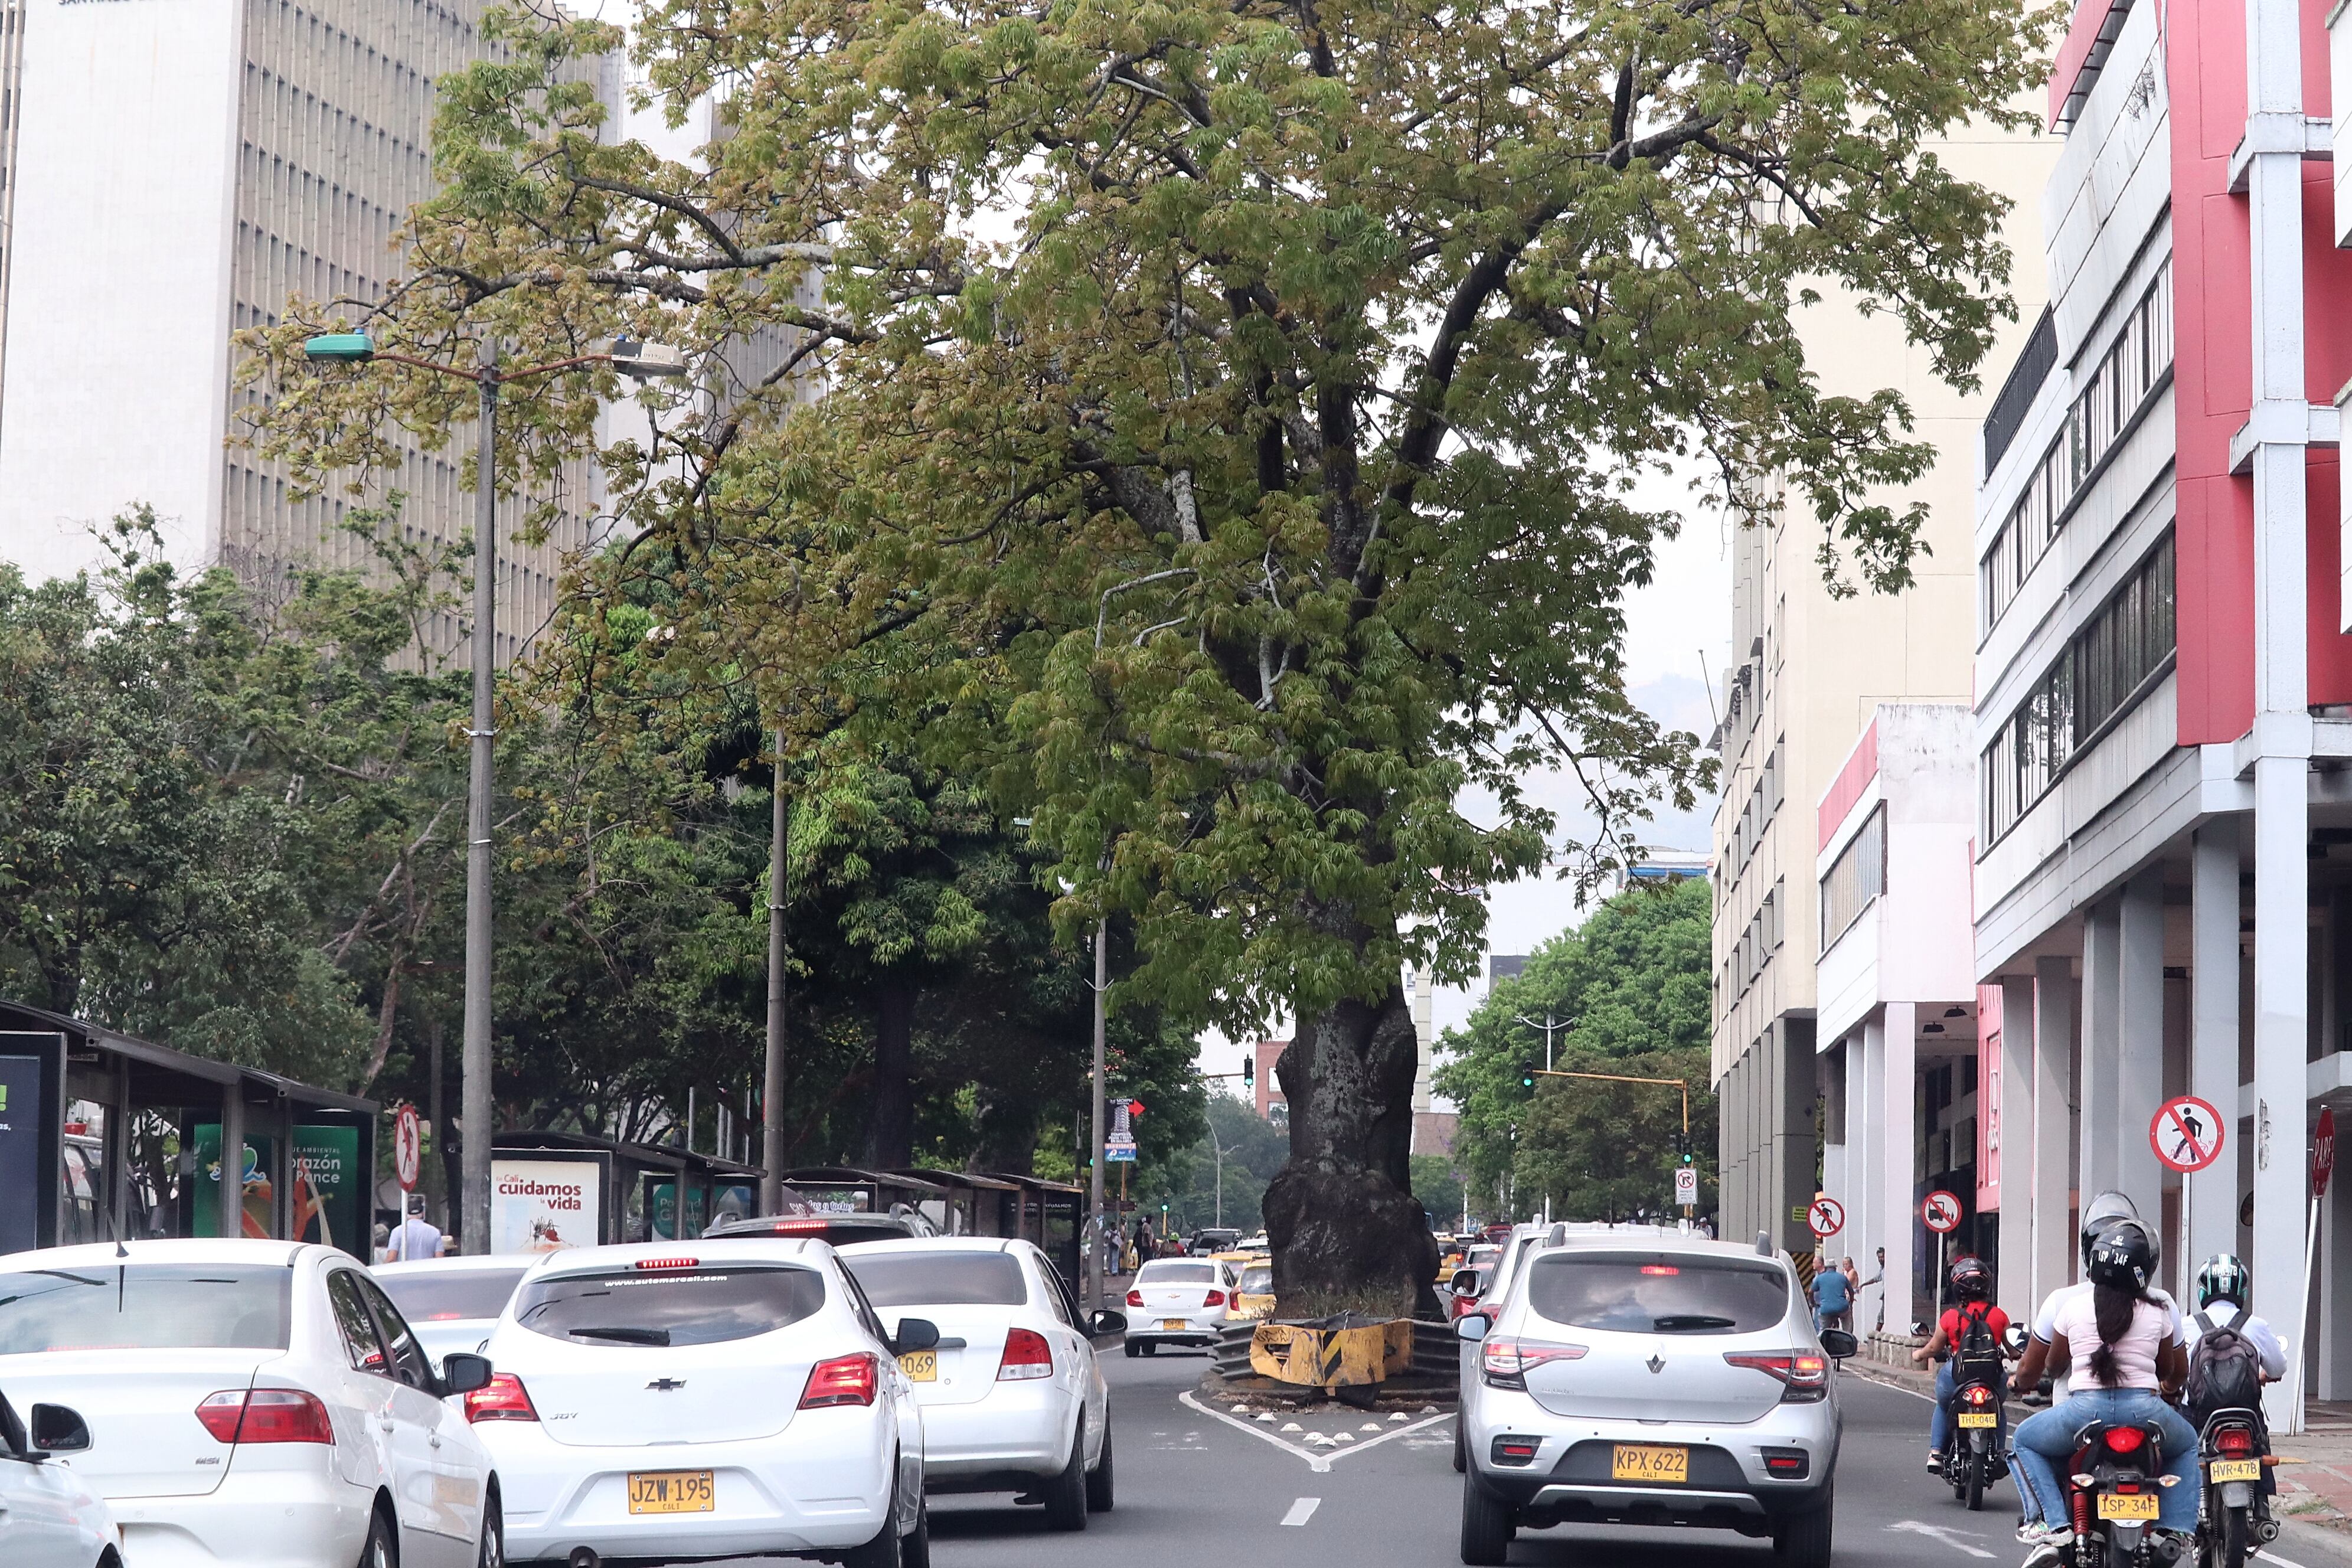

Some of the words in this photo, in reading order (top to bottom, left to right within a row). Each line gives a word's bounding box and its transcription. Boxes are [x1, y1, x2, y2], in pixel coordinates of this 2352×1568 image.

[2313, 1135, 2333, 1170] PARE
[296, 1170, 340, 1184] Pance
[499, 1180, 582, 1196] cuidamos
[547, 1197, 582, 1210] vida
[2098, 1250, 2109, 1263] ISP
[2114, 1253, 2129, 1266] 34F
